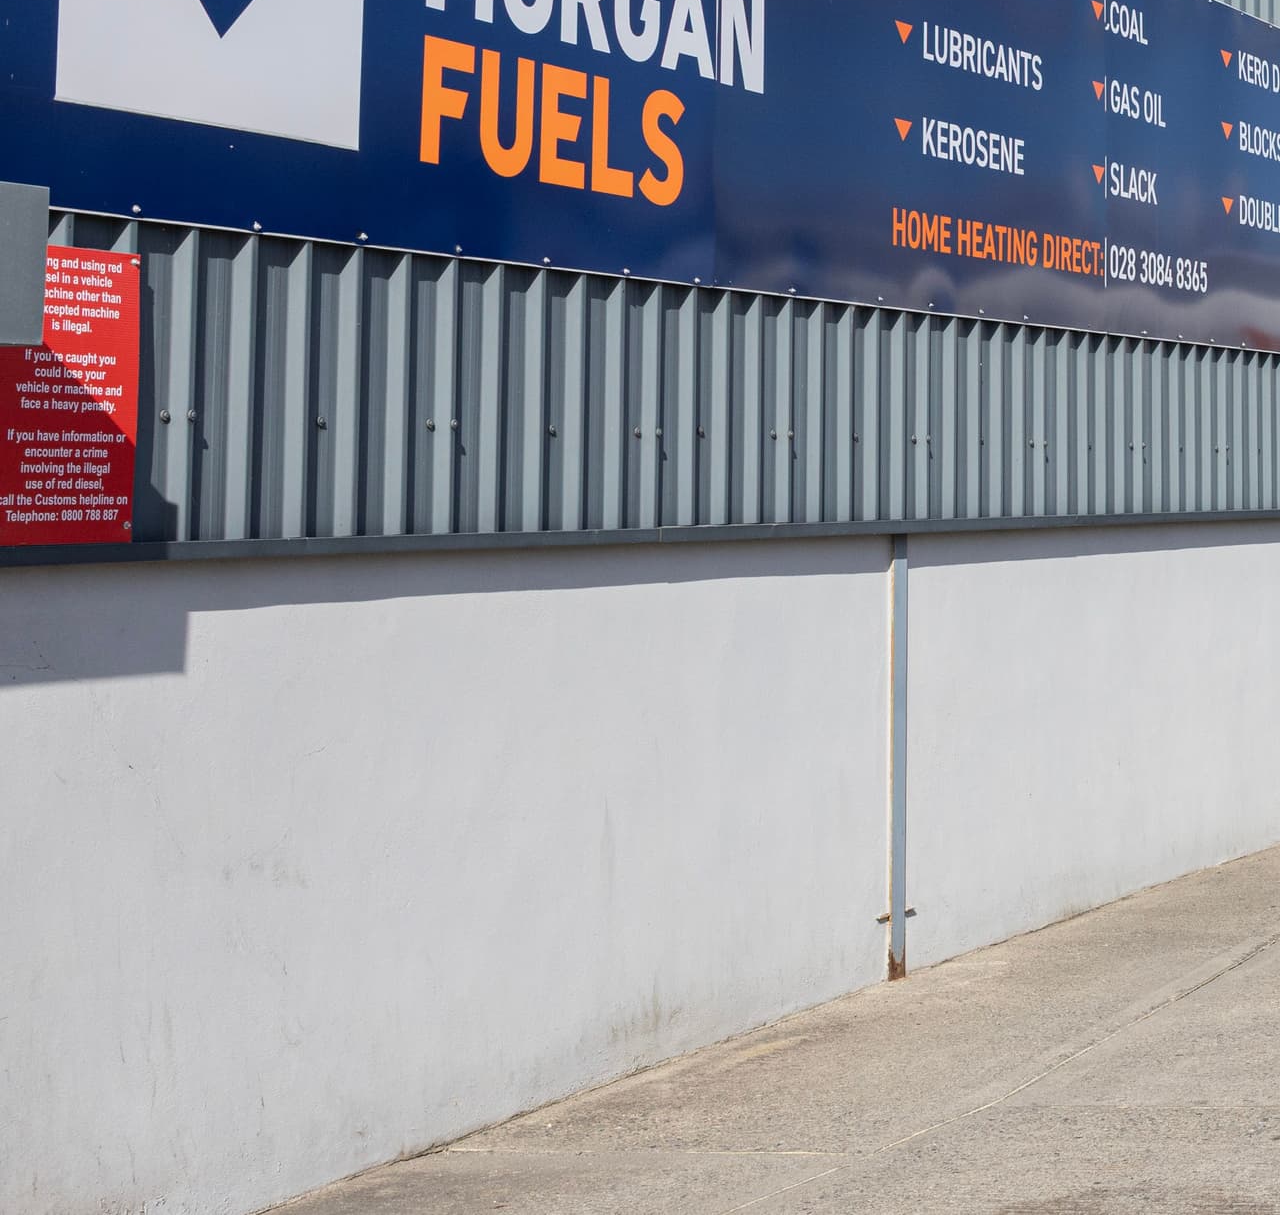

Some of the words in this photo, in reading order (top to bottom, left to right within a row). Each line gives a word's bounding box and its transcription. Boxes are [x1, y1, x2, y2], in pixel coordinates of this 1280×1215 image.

[1109, 0, 1148, 46] COAL
[922, 21, 1043, 91] LUBRICANTS
[1238, 50, 1269, 90] KERO
[1110, 79, 1140, 120] GAS
[1144, 90, 1166, 128] OIL
[419, 34, 686, 207] FUELS
[922, 117, 1025, 175] KEROSENE
[1110, 162, 1158, 206] SLACK
[892, 207, 951, 255] HOME
[957, 218, 1038, 269] HEATING
[1110, 244, 1136, 281] 028
[1140, 250, 1173, 288] 3084
[1176, 257, 1208, 293] 8365
[61, 258, 79, 269] and
[81, 260, 106, 274] using
[107, 263, 122, 274] red
[62, 272, 70, 284] in
[73, 276, 79, 285] a
[81, 274, 113, 288] vehicle
[44, 287, 74, 300] achine
[76, 289, 100, 302] other
[102, 292, 121, 304] than
[43, 304, 80, 317] xcepted
[81, 306, 120, 319] machine
[51, 319, 60, 330] is
[62, 319, 92, 334] illegal.
[25, 348, 32, 360] If
[33, 350, 63, 363] you're
[65, 353, 97, 366] caught
[99, 355, 116, 367] you
[35, 366, 61, 378] could
[63, 367, 82, 379] lose
[85, 370, 107, 382] your
[16, 381, 49, 393] vehicle
[52, 385, 62, 394] or
[64, 383, 103, 395] machine
[105, 385, 122, 396] and
[21, 396, 41, 409] face
[43, 401, 49, 409] a
[51, 398, 79, 413] heavy
[81, 400, 116, 414] penalty.
[7, 428, 15, 441] If
[16, 431, 34, 443] you
[37, 430, 59, 441] have
[62, 430, 114, 443] information
[116, 434, 126, 443] or
[24, 447, 73, 458] encounter
[75, 449, 80, 458] a
[82, 447, 108, 458] crime
[20, 461, 64, 476] involving
[67, 462, 80, 474] the
[83, 462, 110, 476] illegal
[25, 479, 43, 490] use
[45, 477, 56, 490] of
[57, 478, 73, 490] red
[75, 478, 104, 491] diesel,
[17, 493, 32, 505] the
[35, 494, 77, 505] Customs
[79, 494, 115, 507] helpline
[116, 496, 128, 505] on
[5, 510, 59, 524] Telephone:
[61, 509, 83, 521] 0800
[85, 509, 101, 521] 788
[103, 509, 119, 521] 887
